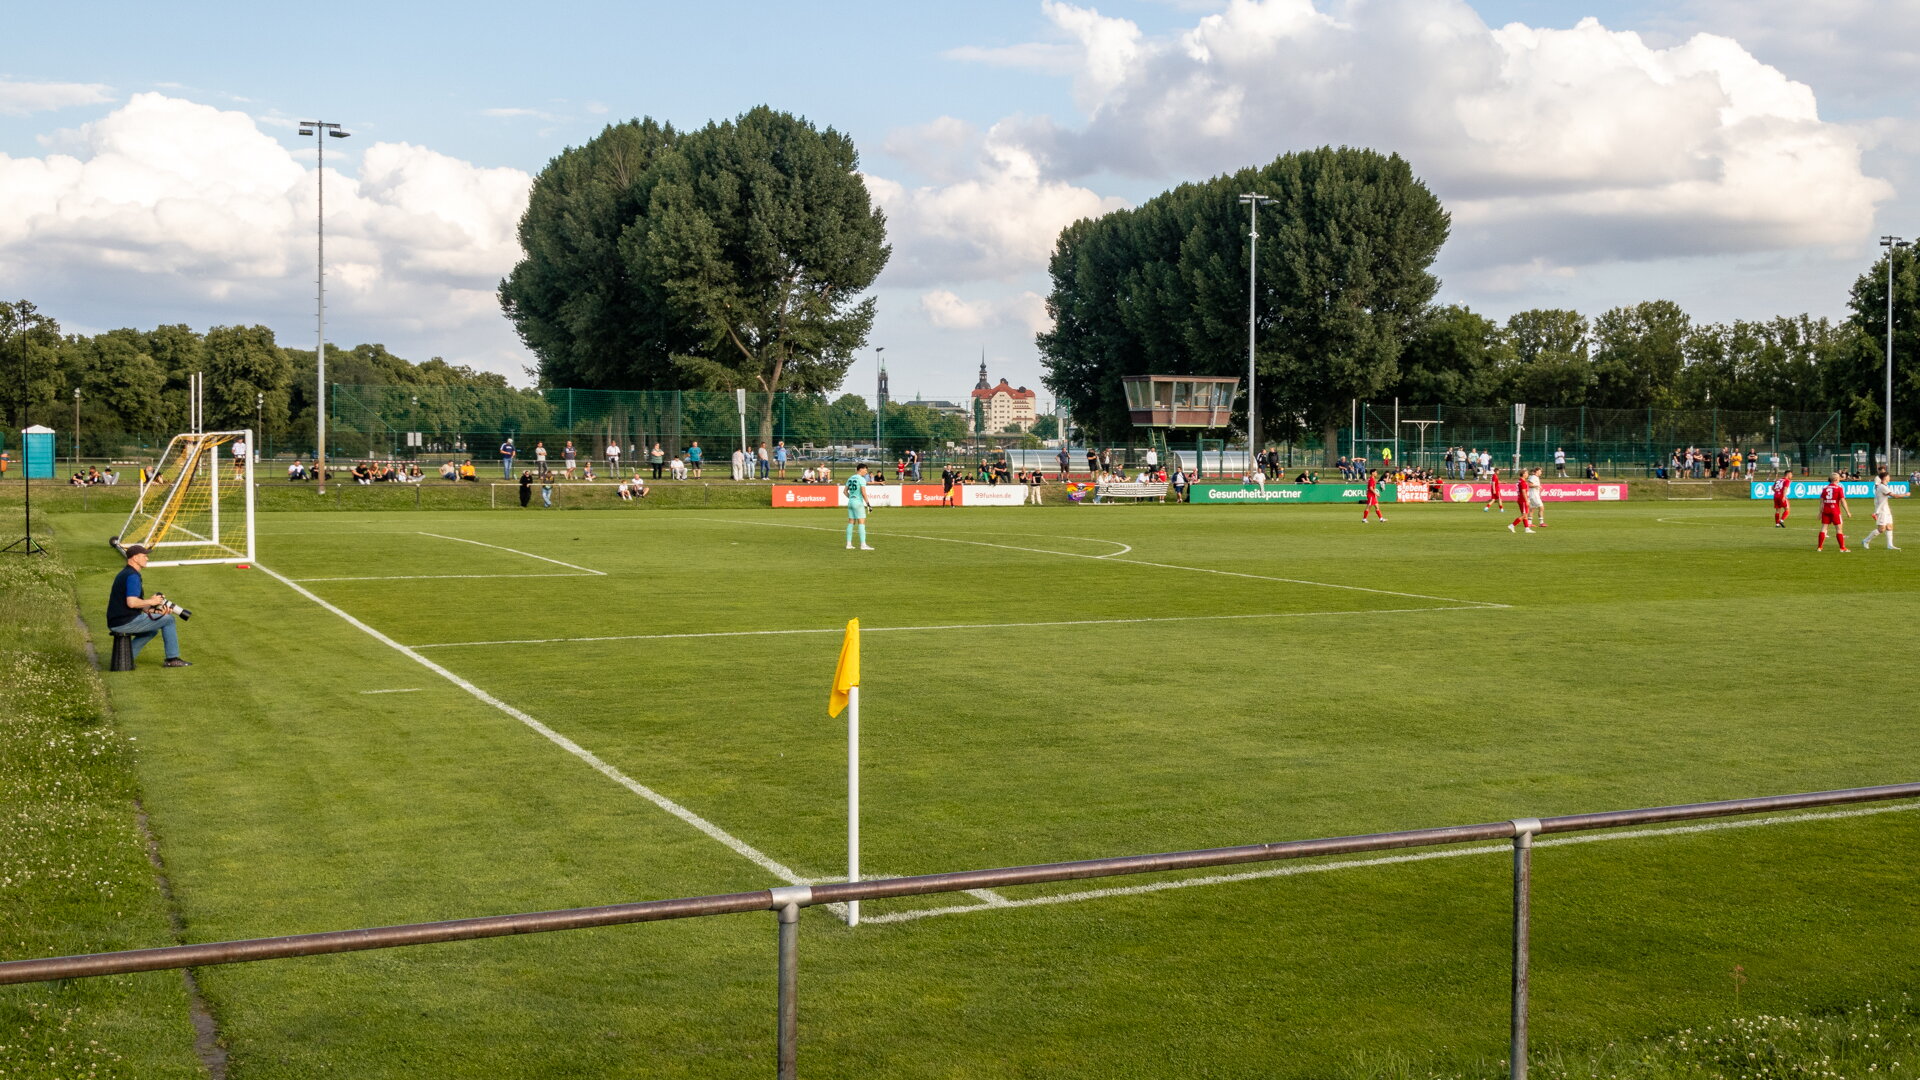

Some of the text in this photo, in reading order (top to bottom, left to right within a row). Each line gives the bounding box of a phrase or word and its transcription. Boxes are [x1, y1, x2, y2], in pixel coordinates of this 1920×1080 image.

[848, 480, 857, 491] 26
[1846, 485, 1869, 495] JAKO
[1888, 485, 1907, 495] AKO
[1208, 489, 1302, 501] Gesundheitspartner
[1826, 488, 1833, 499] 3
